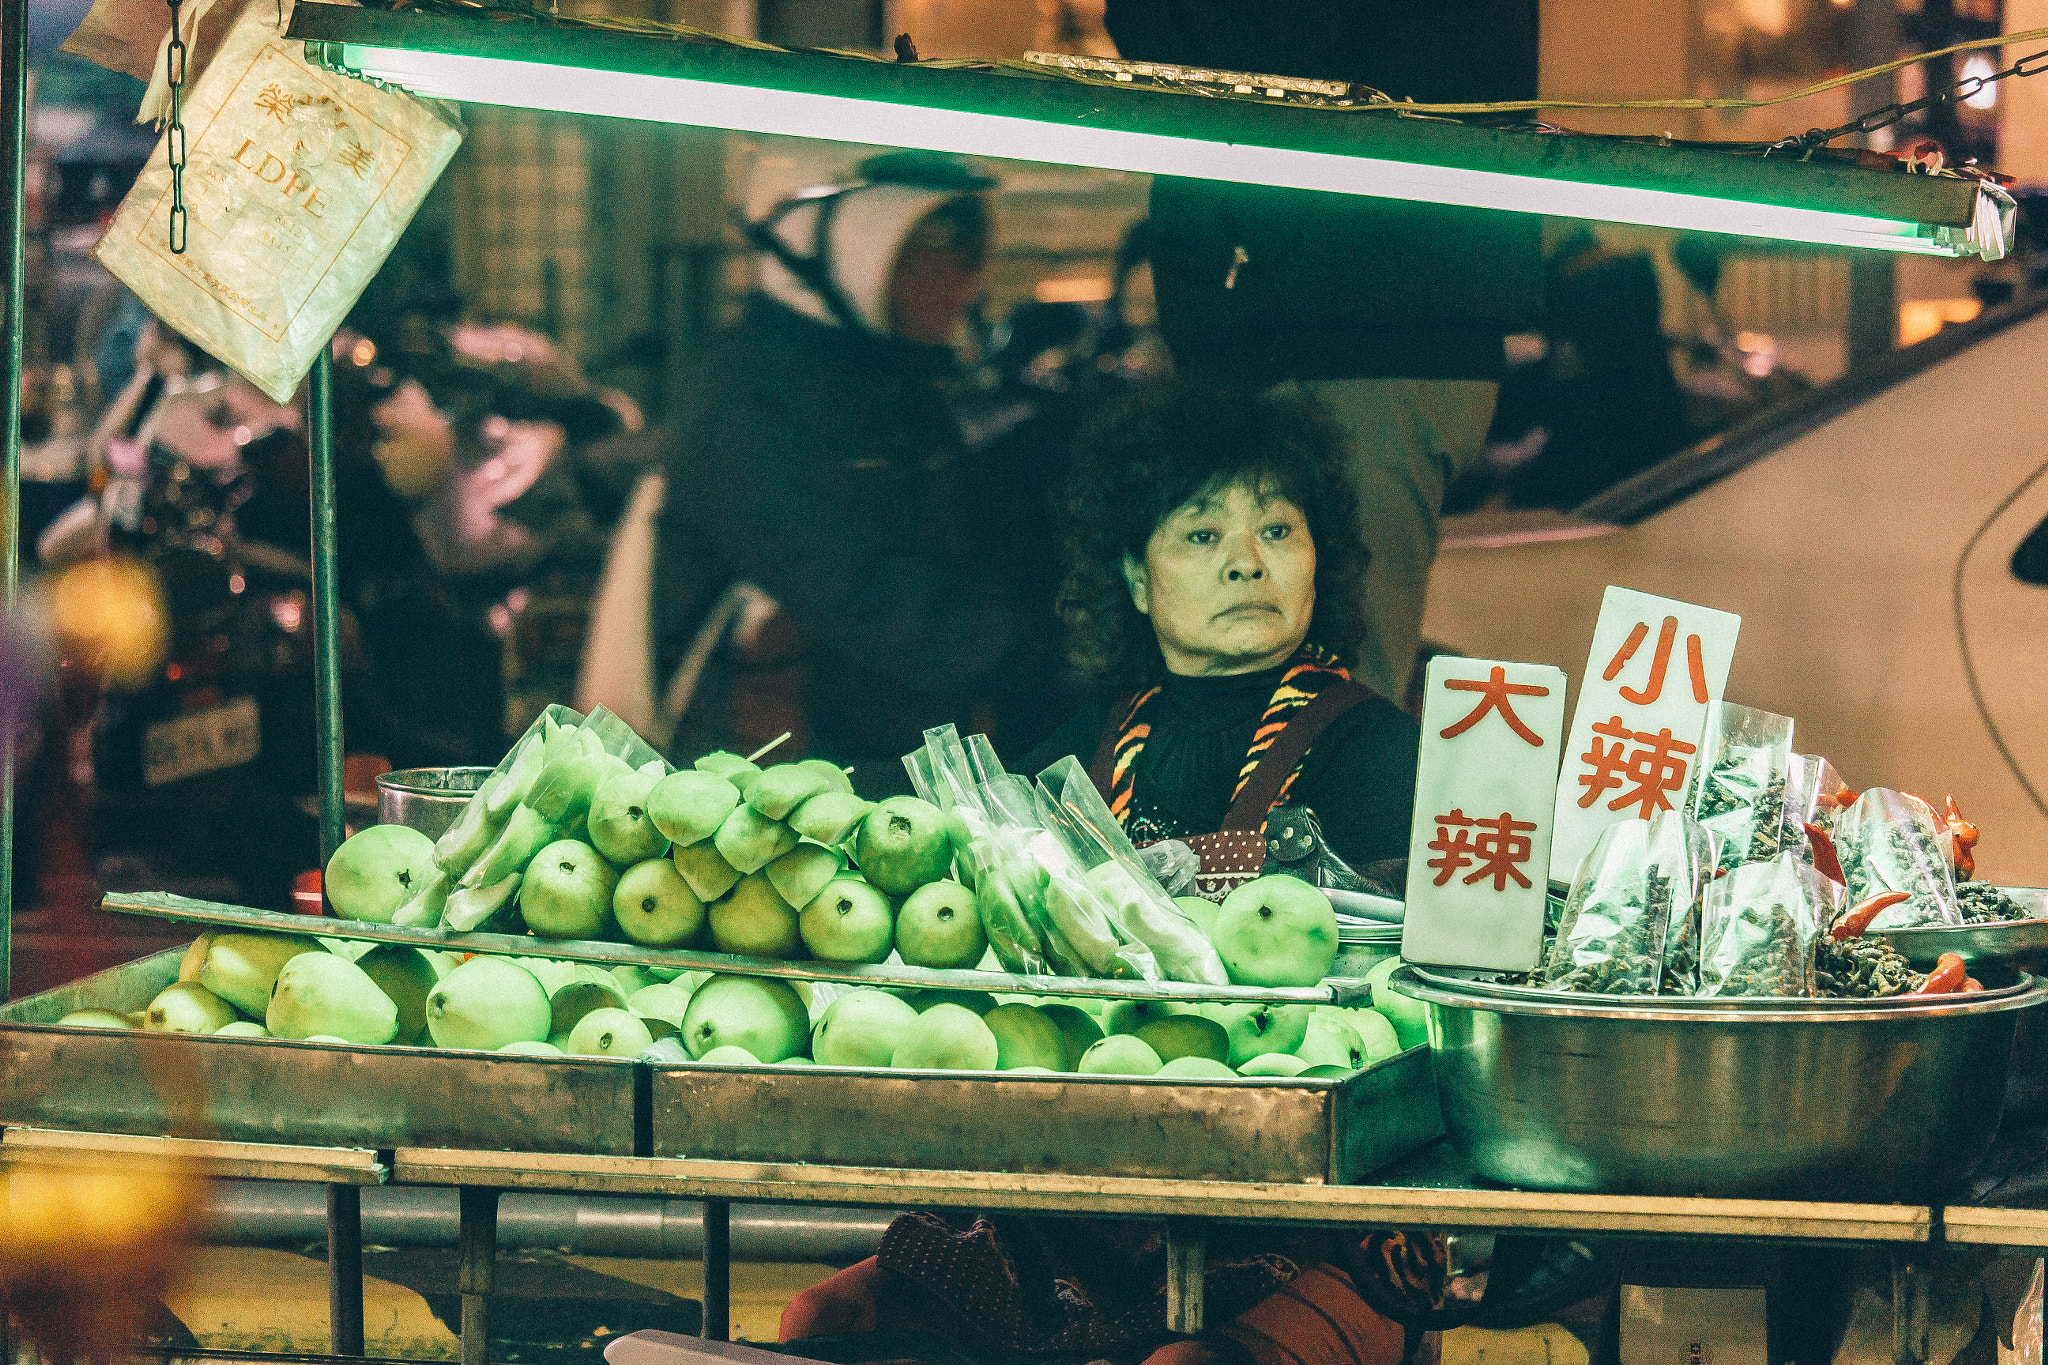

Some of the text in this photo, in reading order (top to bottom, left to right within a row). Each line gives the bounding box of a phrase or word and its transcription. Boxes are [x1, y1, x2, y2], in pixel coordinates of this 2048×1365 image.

[231, 137, 334, 219] LDPE
[1427, 665, 1550, 892] 大辣
[1577, 615, 1709, 821] 小辣
